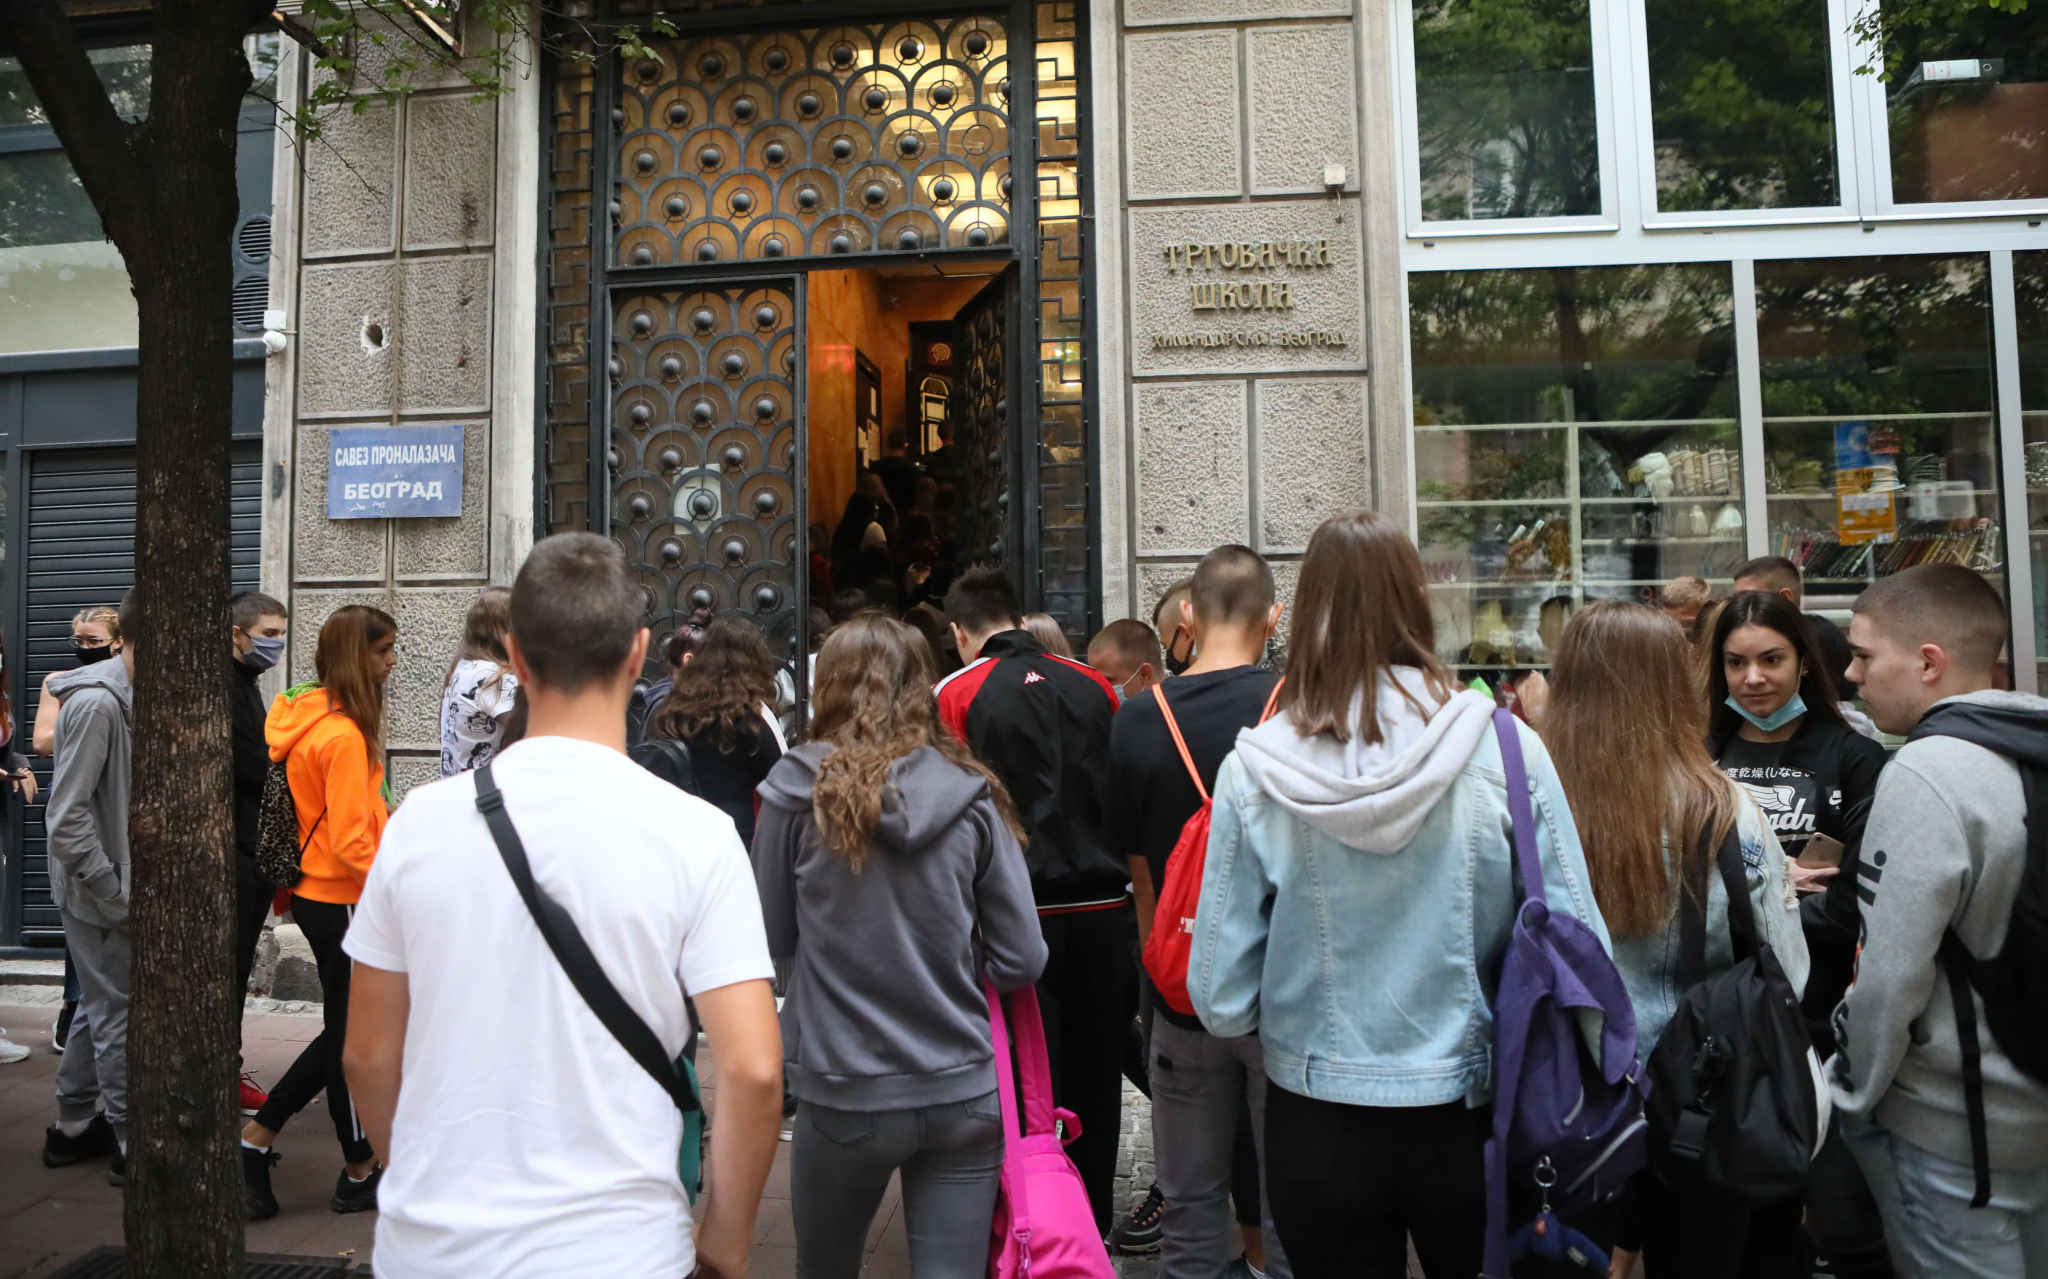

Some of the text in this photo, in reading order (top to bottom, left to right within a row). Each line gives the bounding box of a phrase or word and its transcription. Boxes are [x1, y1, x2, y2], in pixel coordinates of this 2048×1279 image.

[1163, 238, 1333, 271] ТРГОВАЧКА
[1191, 281, 1295, 310] ШКОЛА
[1280, 331, 1347, 347] БЕОГРАД
[335, 444, 456, 467] САВЕЗ ПРОНАЛАЗАЧА
[344, 481, 444, 501] БЕОГРАД
